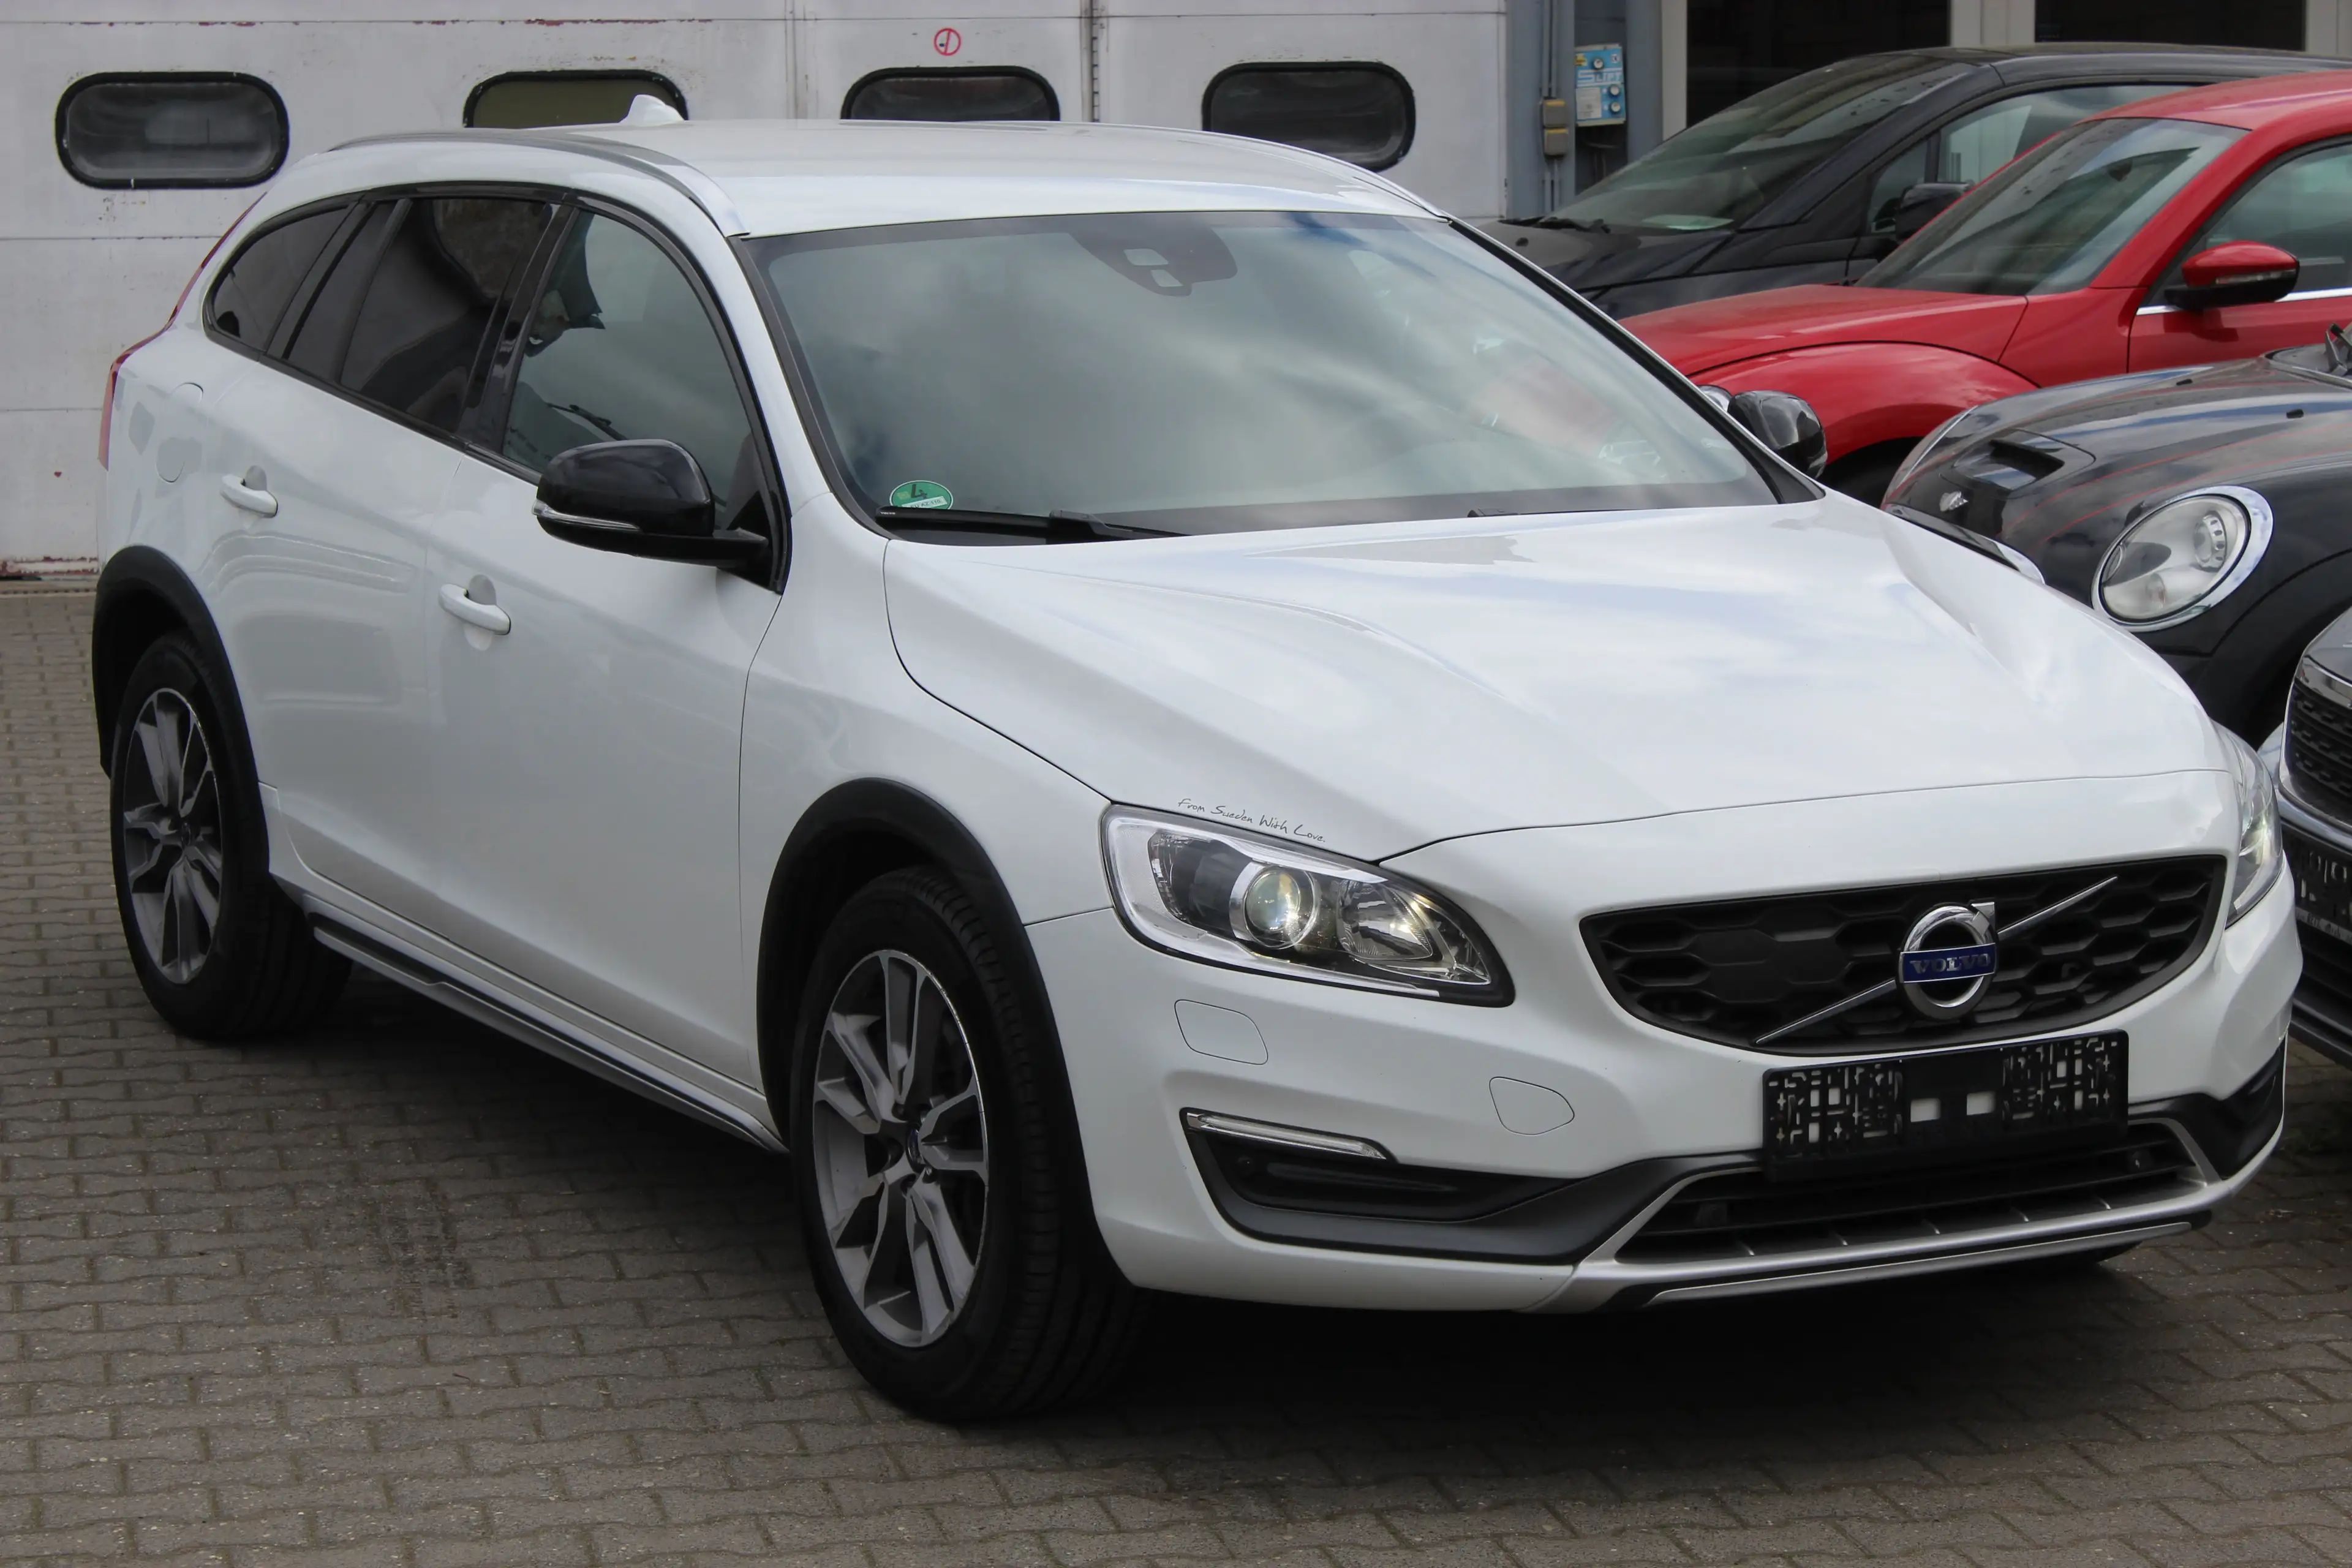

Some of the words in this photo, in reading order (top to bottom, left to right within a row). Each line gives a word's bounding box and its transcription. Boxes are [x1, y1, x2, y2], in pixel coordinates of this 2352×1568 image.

[911, 483, 928, 499] 4
[1178, 797, 1205, 813] From
[1210, 805, 1253, 824] Sweden
[1259, 814, 1288, 834] With
[1909, 952, 1991, 974] VOLVO
